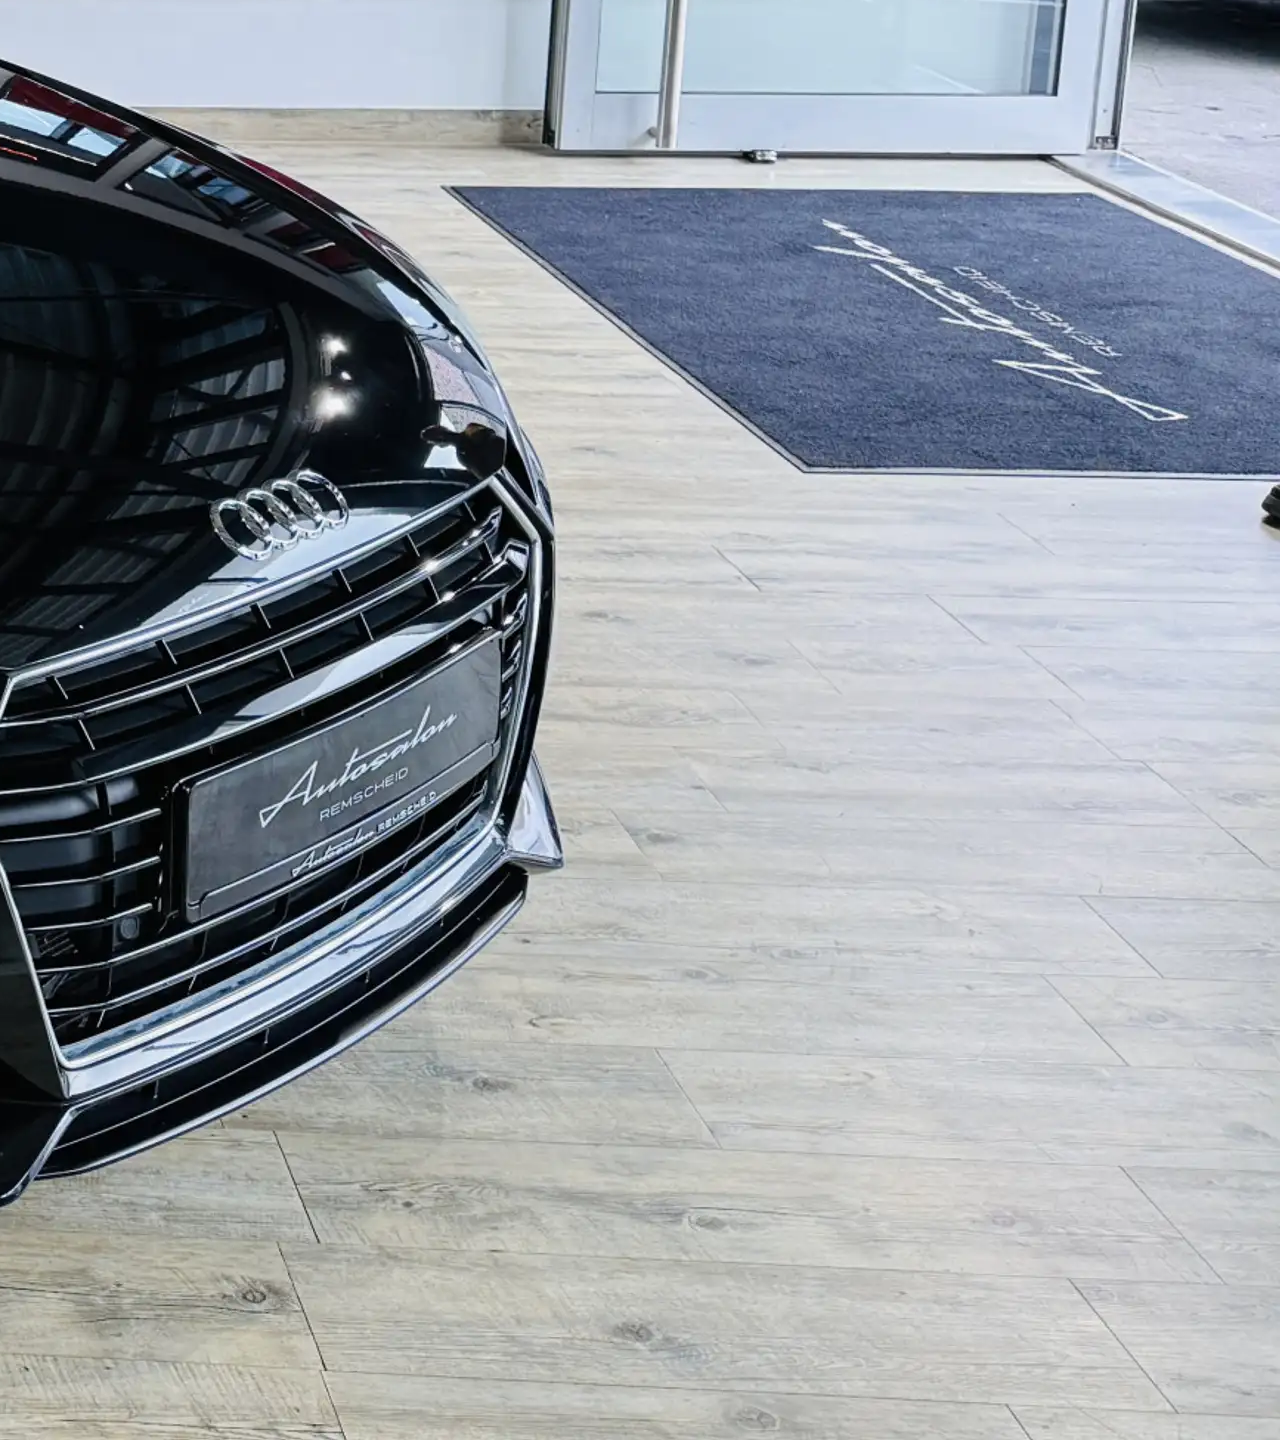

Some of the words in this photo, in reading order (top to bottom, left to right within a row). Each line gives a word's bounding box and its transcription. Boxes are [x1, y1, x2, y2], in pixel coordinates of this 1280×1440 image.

[811, 217, 1190, 423] Autosalon
[951, 264, 1124, 358] REMSCHEID
[258, 703, 459, 829] Autosalon
[318, 766, 410, 823] REMSCHEID
[376, 789, 438, 834] REMSCHEID
